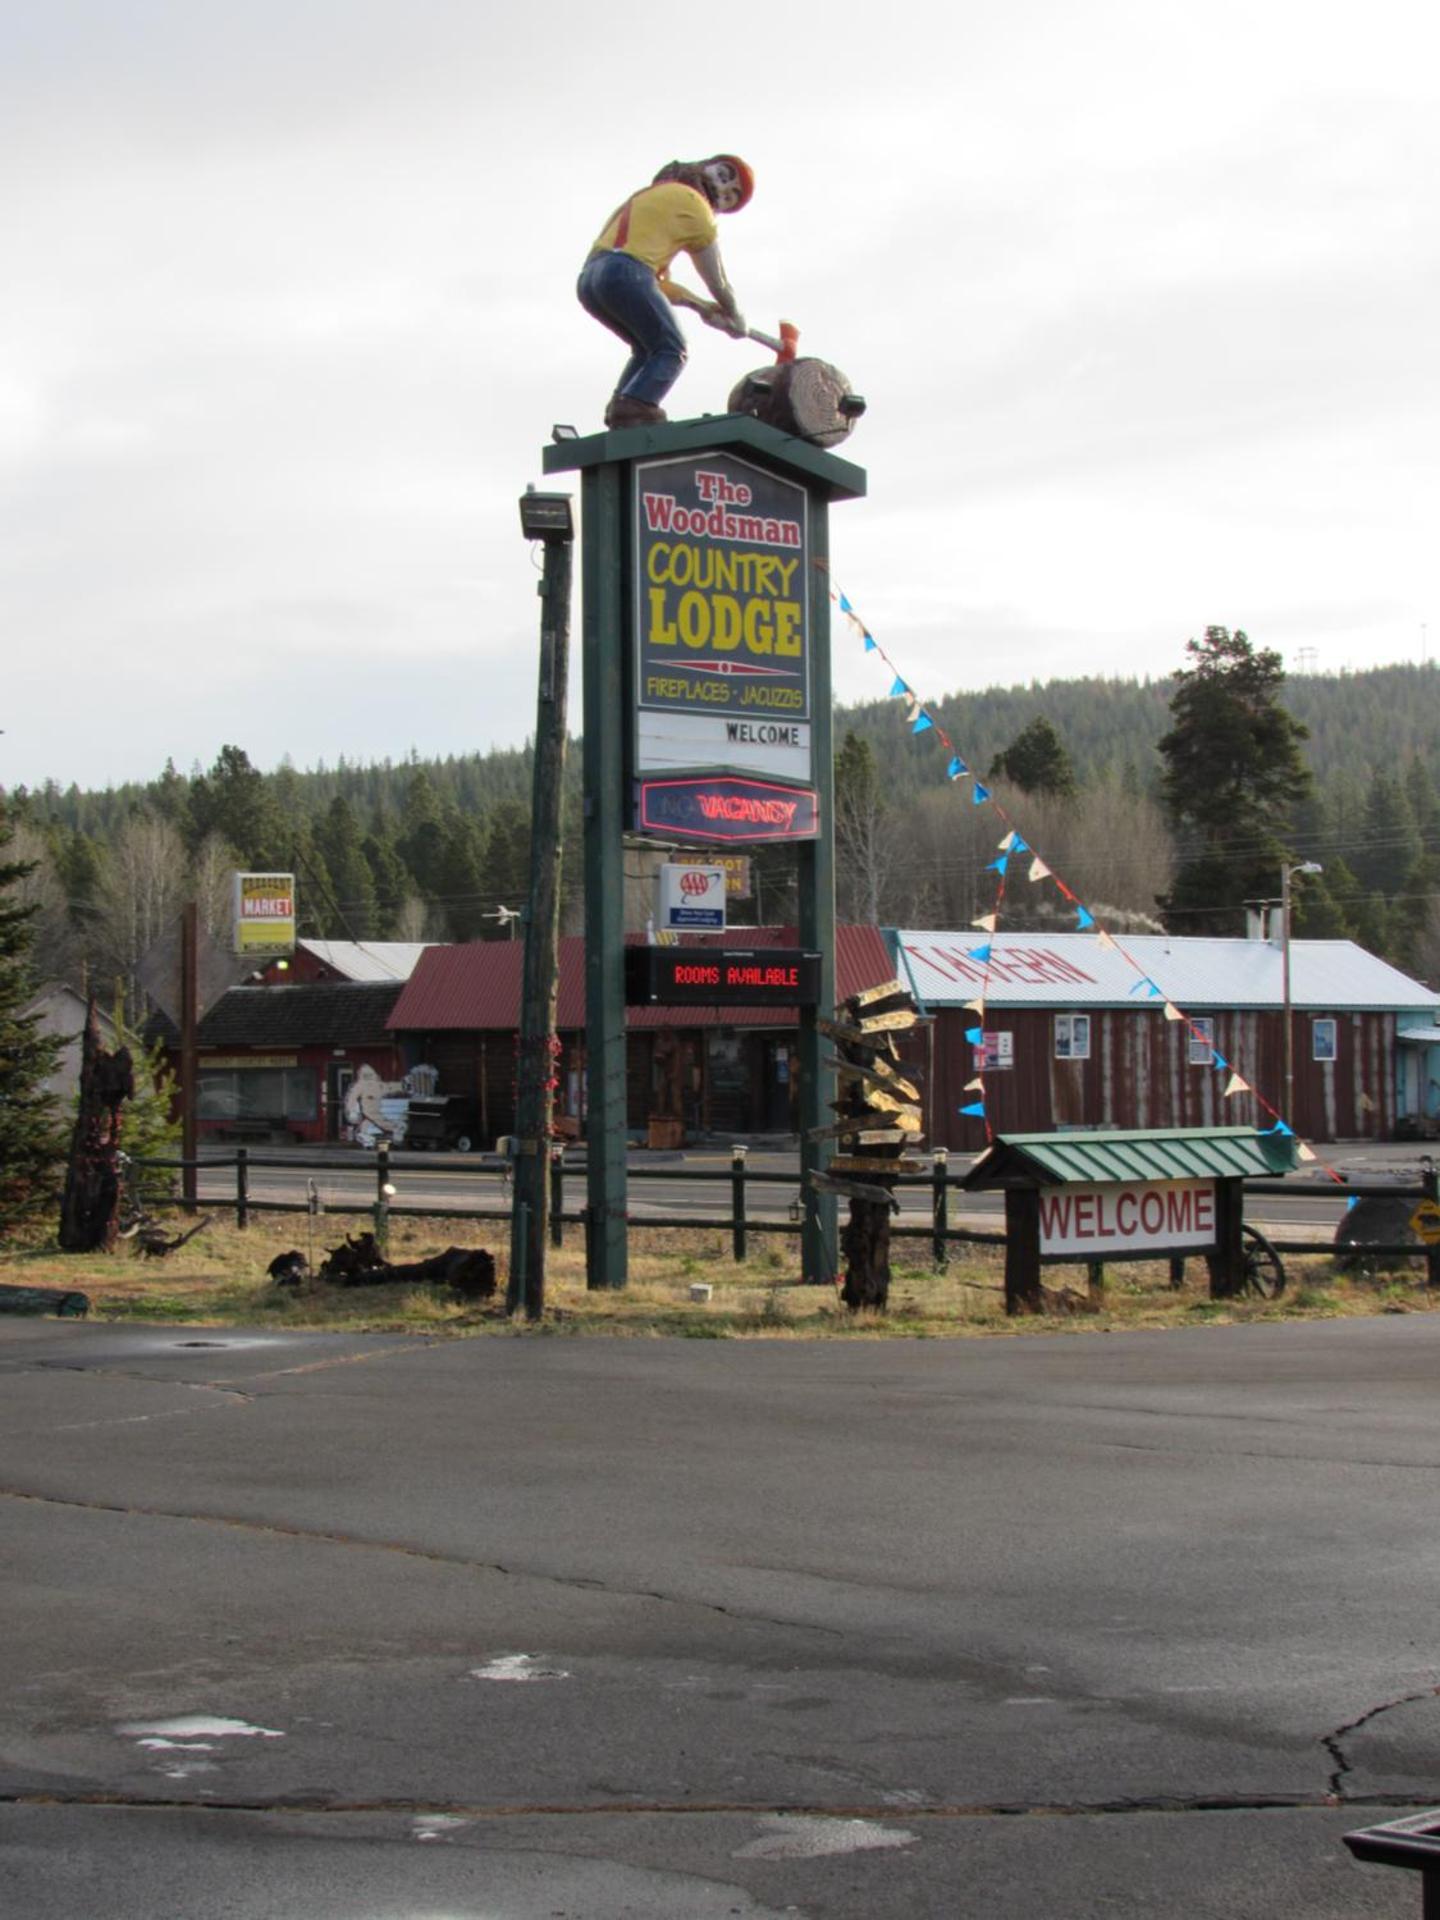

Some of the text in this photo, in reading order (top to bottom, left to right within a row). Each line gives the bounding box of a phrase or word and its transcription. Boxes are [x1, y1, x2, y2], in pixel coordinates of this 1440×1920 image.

[695, 471, 751, 506] The
[644, 492, 801, 548] Woodsman
[648, 542, 799, 597] COUNTRY
[648, 587, 801, 657] LODGE
[647, 677, 730, 702] FIREPLACES
[726, 722, 800, 745] WELCOME
[696, 793, 798, 832] VACANCY
[244, 898, 291, 916] MARKET
[674, 965, 799, 986] ROOMS AVAILABLE
[904, 945, 1099, 984] TAVERN
[1039, 1189, 1214, 1240] WELCOME
